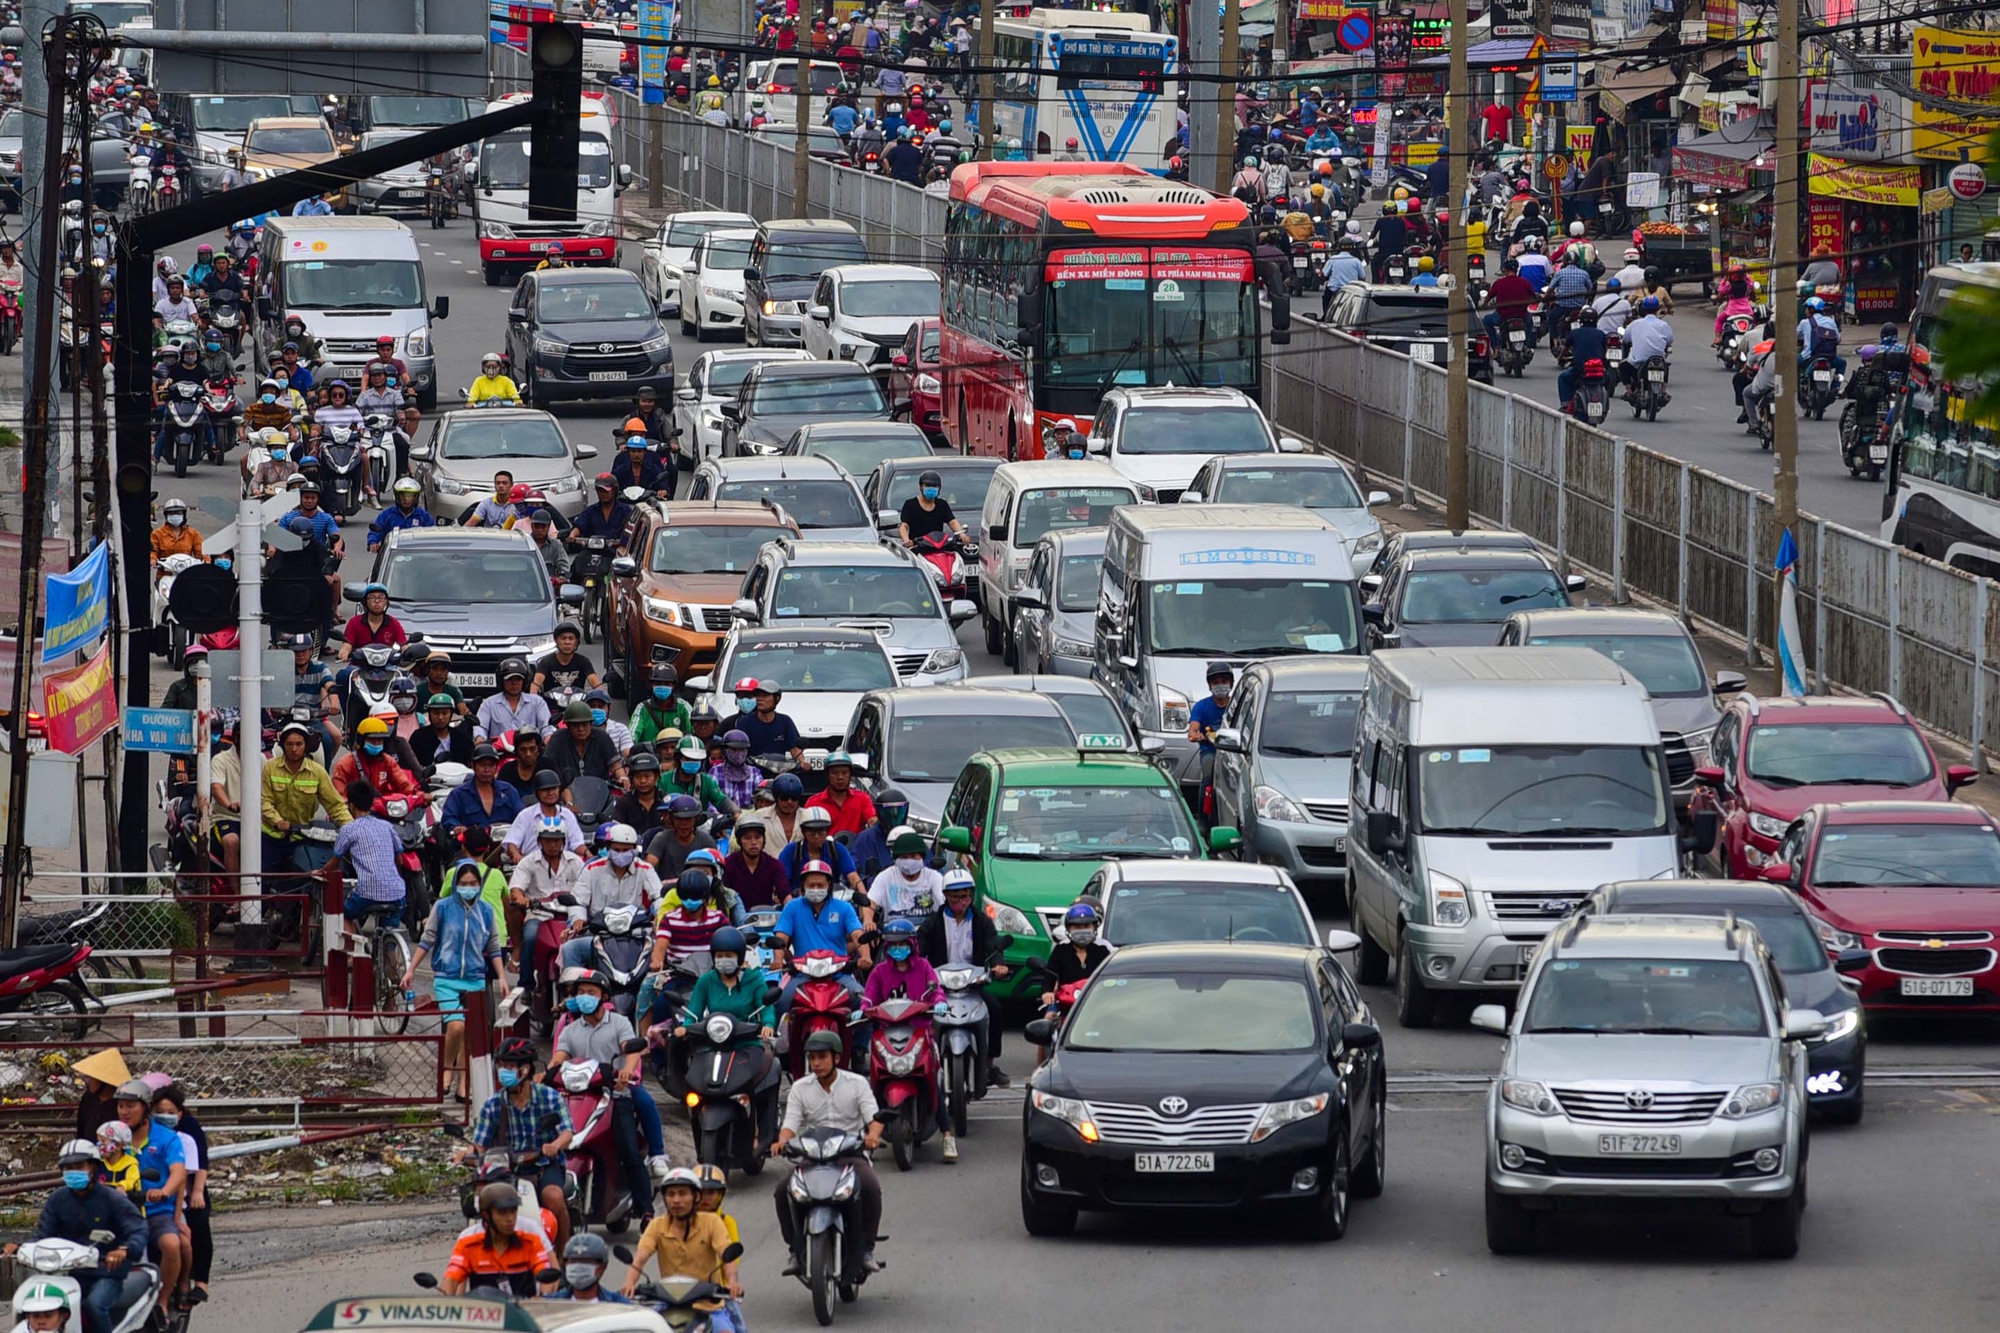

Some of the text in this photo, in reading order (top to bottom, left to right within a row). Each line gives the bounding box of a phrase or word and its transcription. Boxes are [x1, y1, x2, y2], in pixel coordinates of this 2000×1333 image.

[1507, 8, 1529, 20] Nam
[1064, 42, 1077, 53] CHỢ
[1078, 44, 1087, 52] NS
[1088, 42, 1100, 53] THỦ
[1102, 43, 1116, 54] ĐỨC
[1122, 46, 1130, 54] BX
[1131, 44, 1146, 55] MIỀN
[1148, 46, 1160, 56] TÂY
[1812, 224, 1840, 237] 30%
[1108, 253, 1142, 266] TRANG
[1155, 253, 1244, 269] FUTA Bus Lines
[1057, 269, 1075, 280] BẾN
[1094, 268, 1114, 278] MIỀN
[1116, 269, 1143, 278] ĐÔNG
[1157, 270, 1168, 278] BX
[1170, 269, 1184, 278] PHÍA
[1185, 270, 1200, 278] NAM
[1217, 272, 1240, 280] TRANG
[1163, 284, 1175, 293] 28
[1861, 300, 1894, 309] 10.000đ
[1181, 550, 1314, 564] LIMOUSINE
[142, 712, 180, 726] ĐƯỜNG
[125, 729, 144, 743] KHA
[150, 730, 167, 748] VẠN
[1138, 1155, 1211, 1170] 51A-722.64
[380, 1304, 502, 1322] VINASUN TAXI
